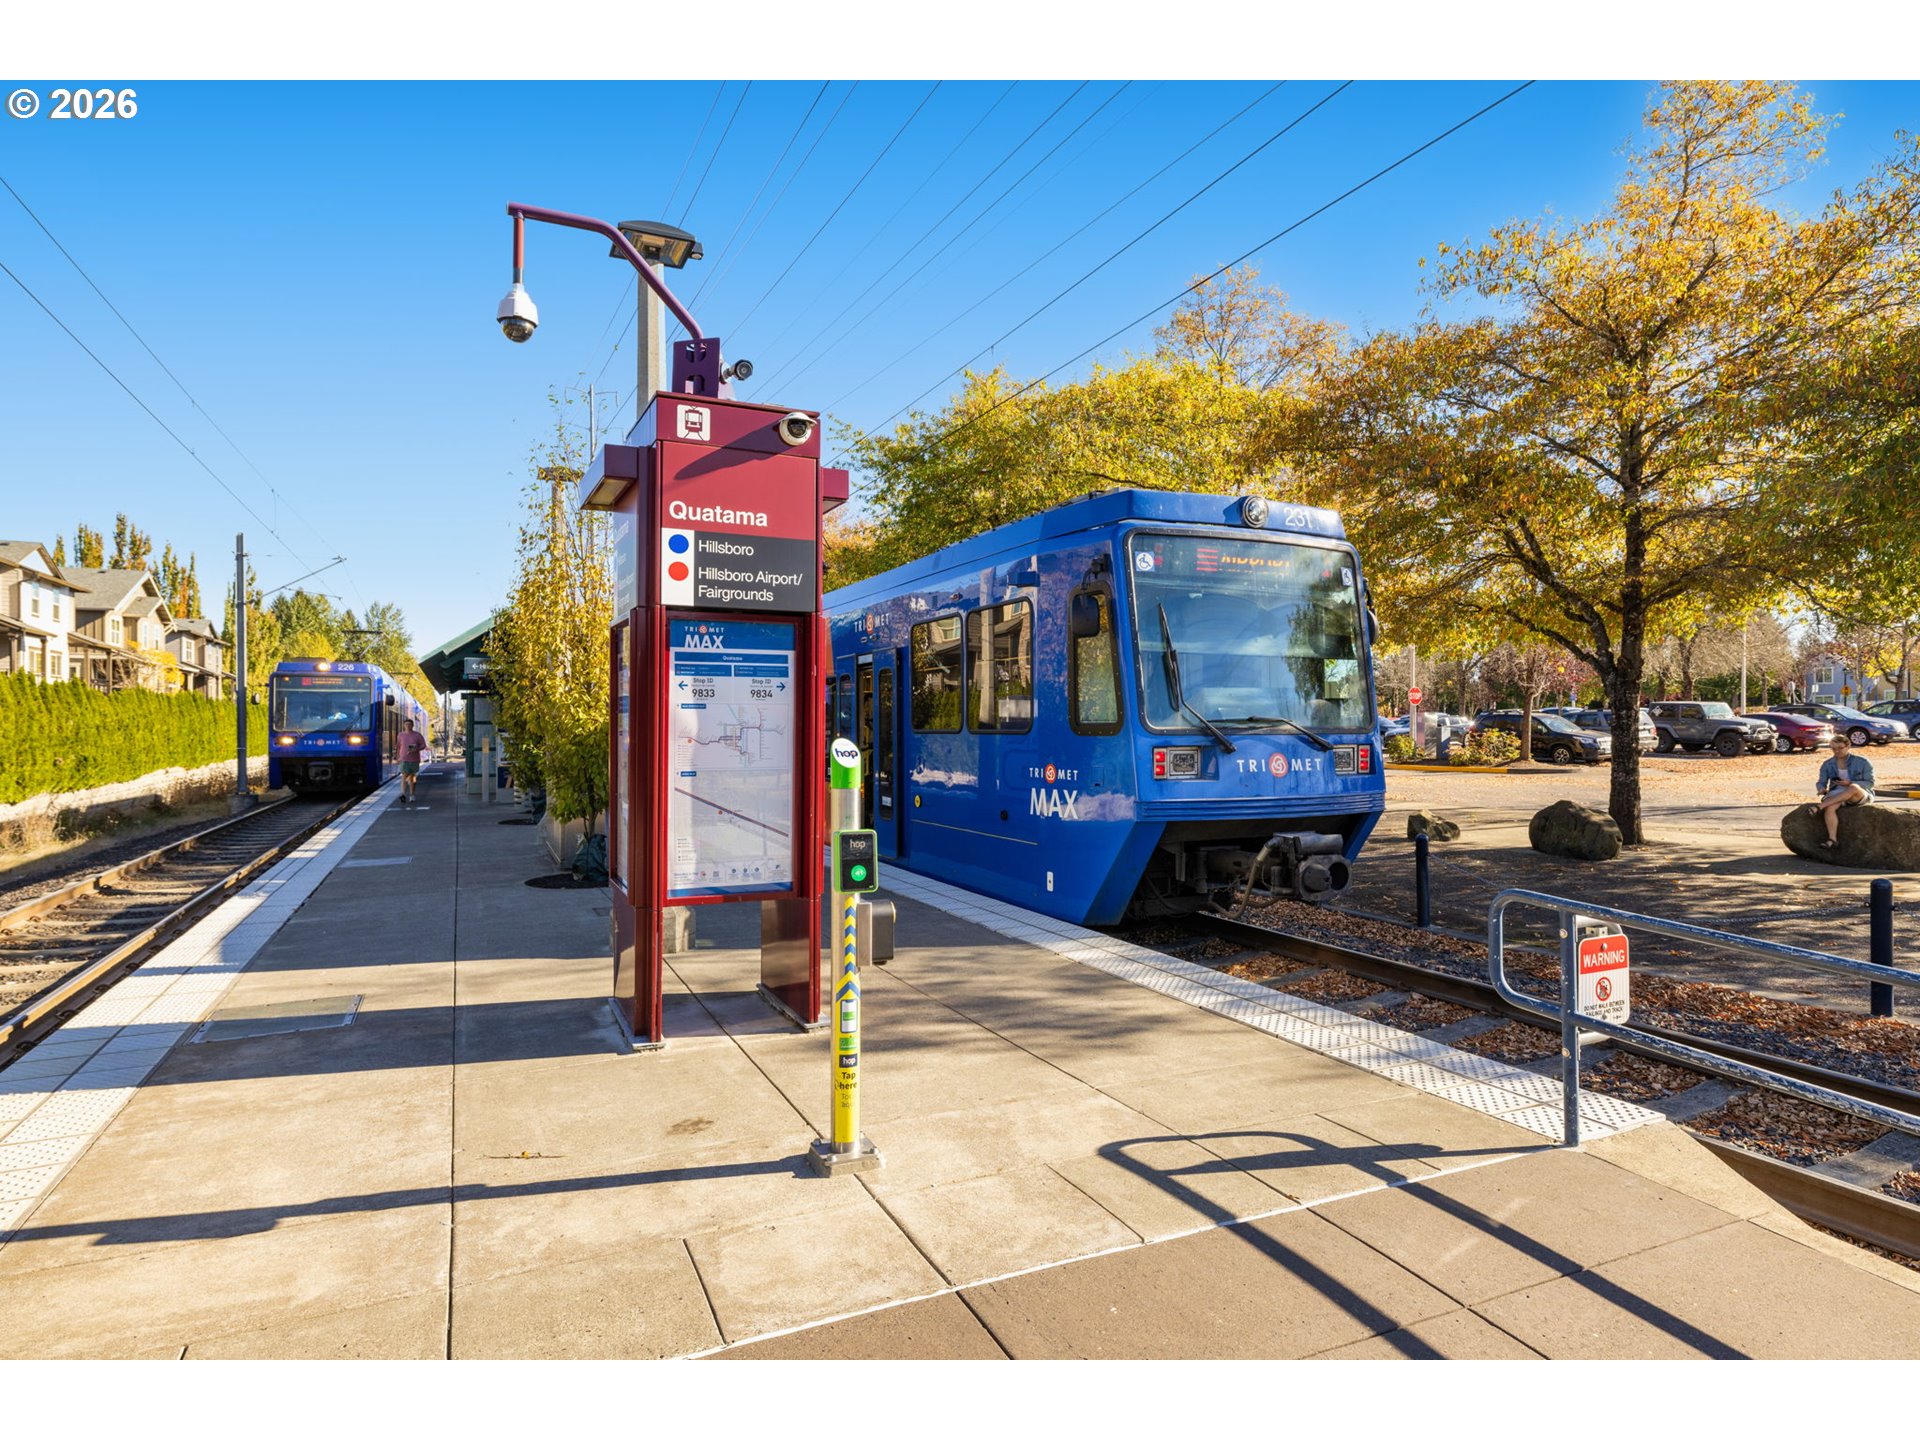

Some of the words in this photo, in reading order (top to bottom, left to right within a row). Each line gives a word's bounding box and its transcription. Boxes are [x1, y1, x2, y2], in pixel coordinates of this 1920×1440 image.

[669, 500, 768, 527] Quatama
[1284, 506, 1313, 529] 231
[698, 540, 754, 556] Hillsboro
[698, 566, 754, 583] Hillsboro
[755, 570, 802, 587] Airport/
[698, 585, 774, 602] Fairgrounds
[684, 634, 724, 649] MAX
[692, 688, 715, 698] 9833
[750, 689, 773, 698] 9834
[834, 747, 859, 759] hop
[1029, 787, 1079, 820] MAX
[849, 838, 866, 851] hop
[1583, 950, 1625, 968] WARNING
[843, 1057, 856, 1065] hop
[842, 1072, 856, 1080] Tap
